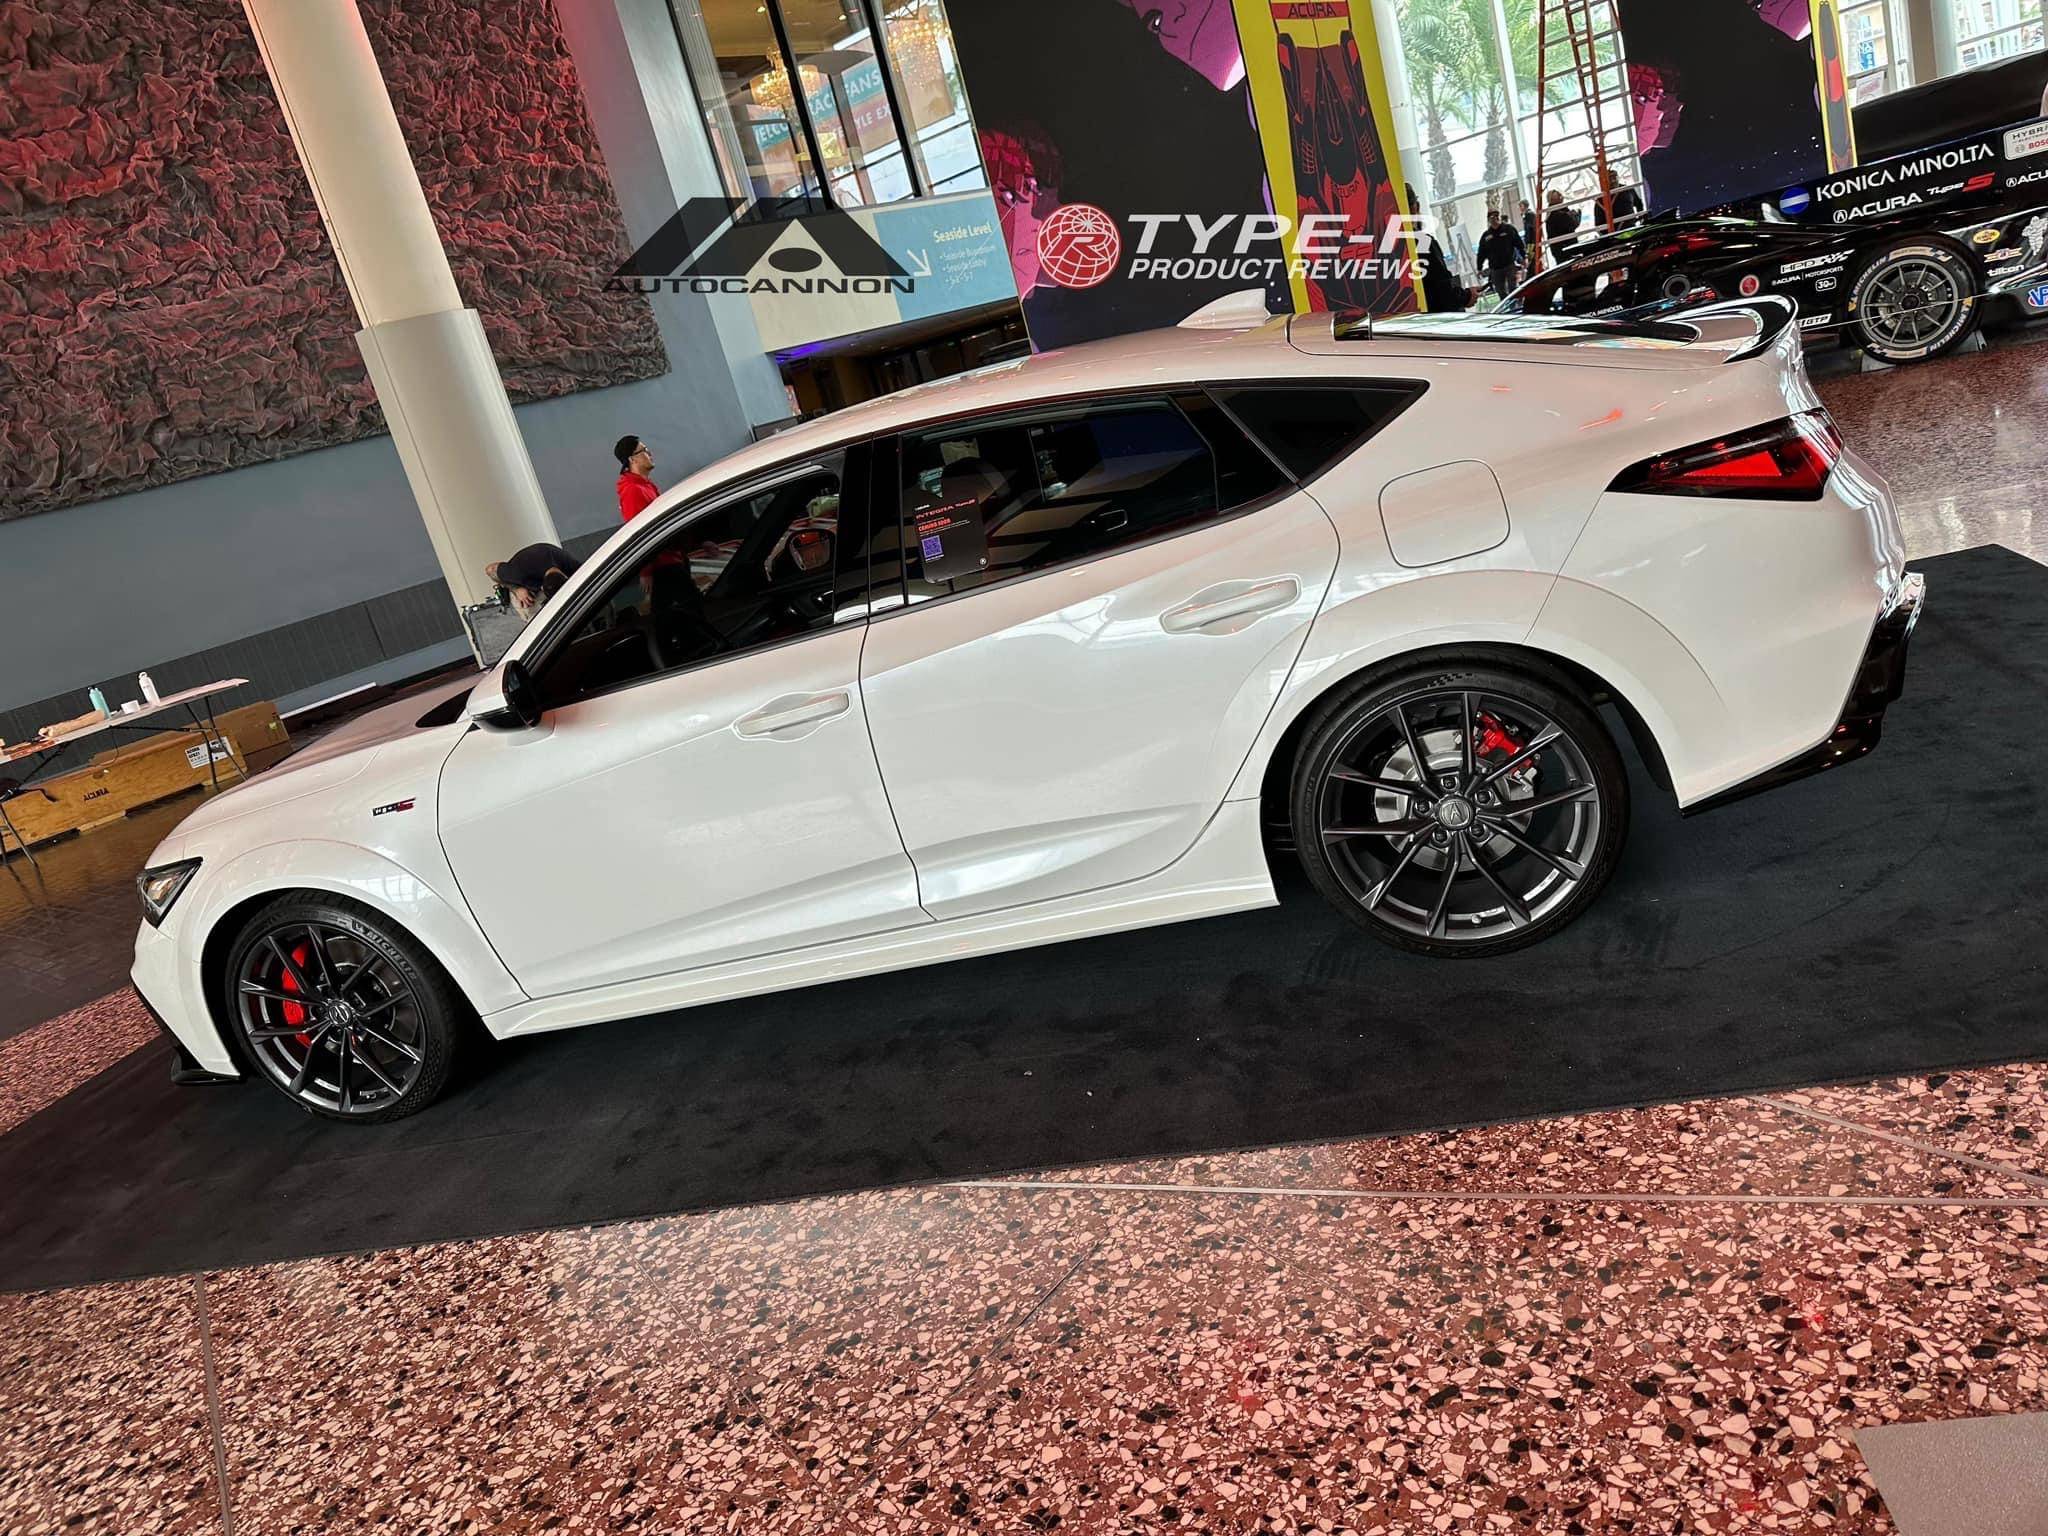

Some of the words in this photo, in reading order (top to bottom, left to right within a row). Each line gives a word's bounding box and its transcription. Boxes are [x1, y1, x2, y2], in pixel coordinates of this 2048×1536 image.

[1288, 3, 1337, 18] ACURA
[2012, 124, 2048, 140] HYBRI
[1816, 169, 1895, 202] KONICA
[1899, 143, 1995, 181] MINOLTA
[2018, 169, 2048, 185] ACU
[1848, 192, 1923, 220] ACURA
[933, 226, 968, 243] Seaside
[968, 220, 993, 237] Level
[1776, 275, 1801, 285] ACURA
[1804, 265, 1844, 278] MOTORSPORTS
[1852, 256, 1887, 297] MICHELIN
[1986, 264, 2025, 277] tilton
[1929, 313, 1967, 352] MICHELIN
[915, 505, 955, 519] INTEGRA
[83, 787, 110, 801] ACURA
[366, 929, 418, 981] MICHELIN
